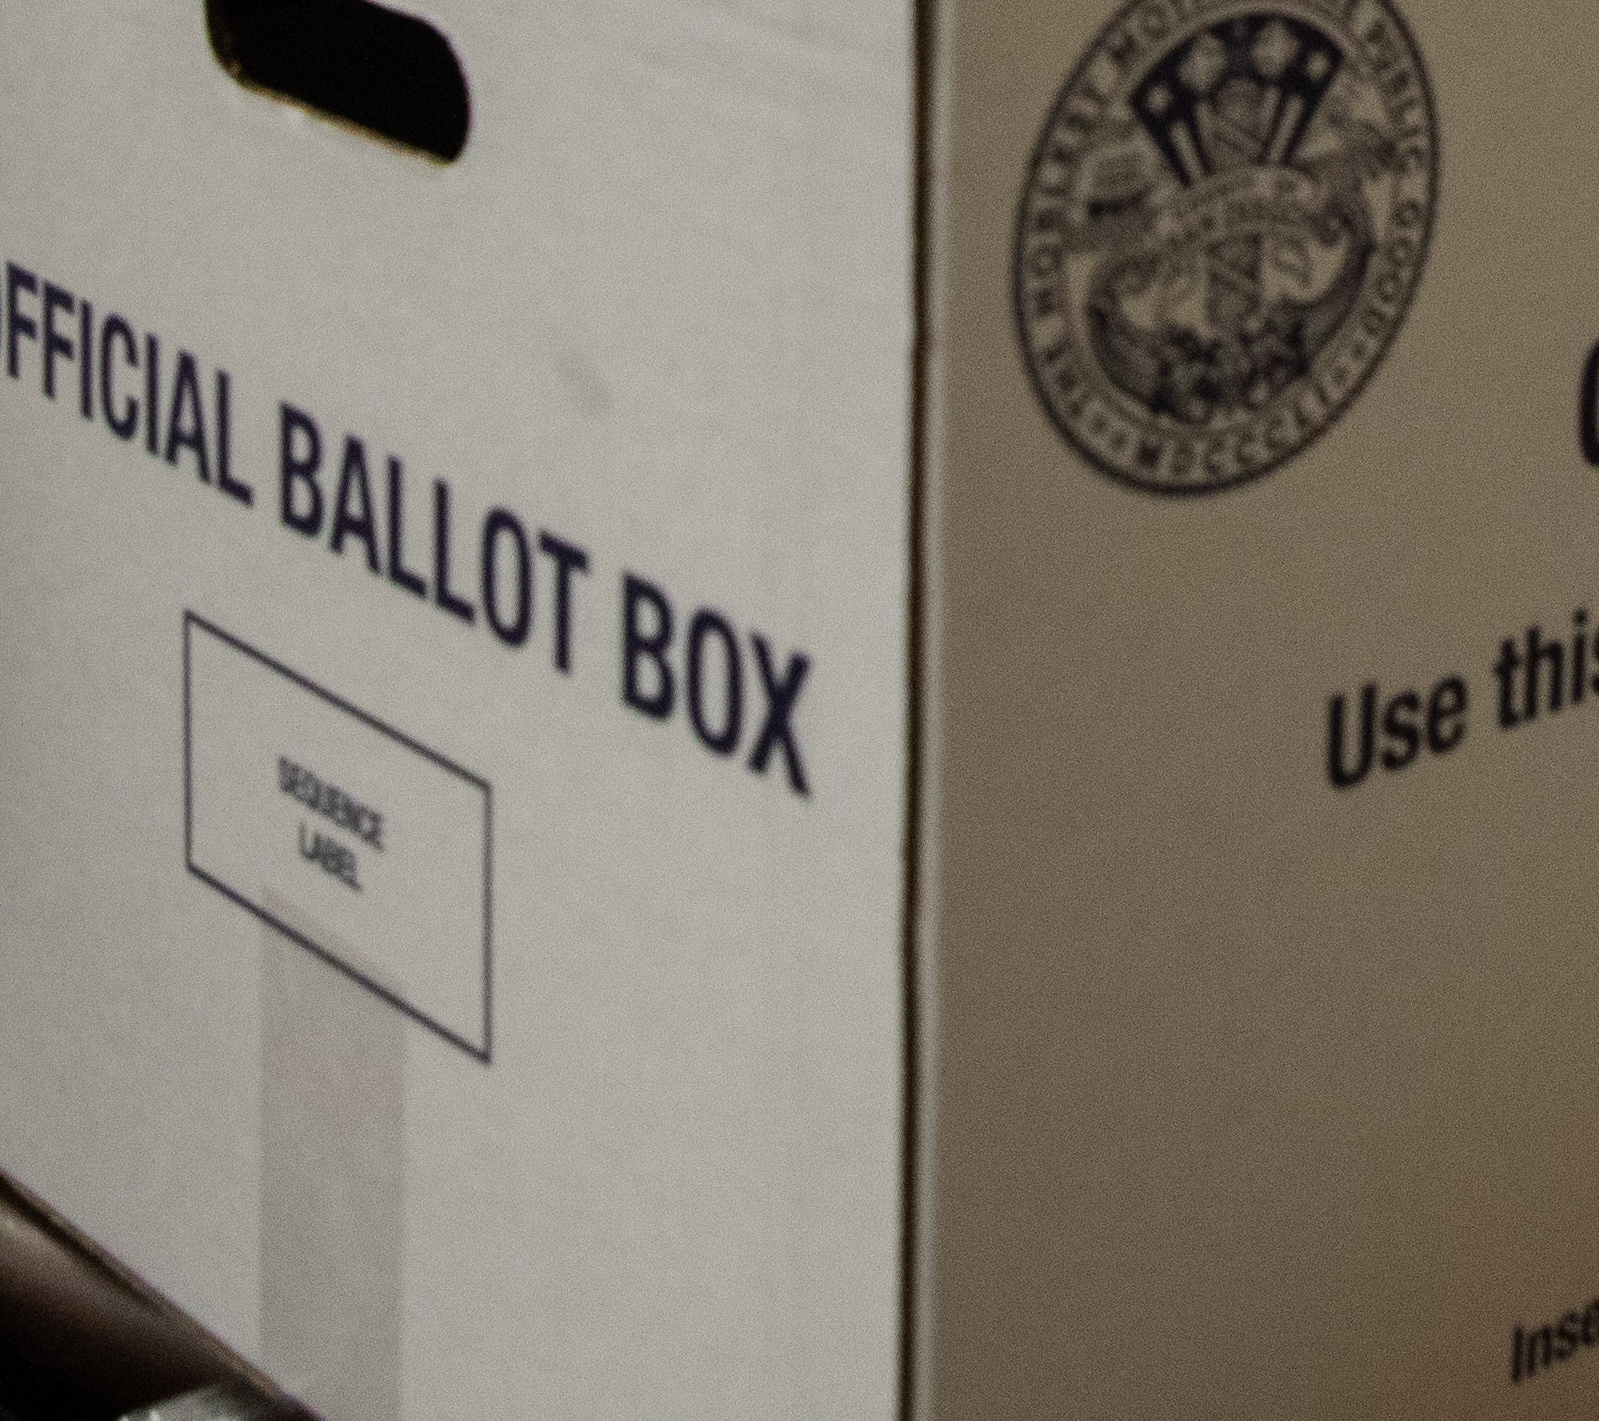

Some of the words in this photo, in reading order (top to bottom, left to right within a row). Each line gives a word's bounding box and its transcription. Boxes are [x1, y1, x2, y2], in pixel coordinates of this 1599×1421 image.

[279, 402, 590, 675] BALLOT
[623, 574, 809, 795] BOX
[1327, 677, 1467, 789] Use
[278, 758, 385, 853] SEQUENCE
[298, 822, 363, 892] LABEL
